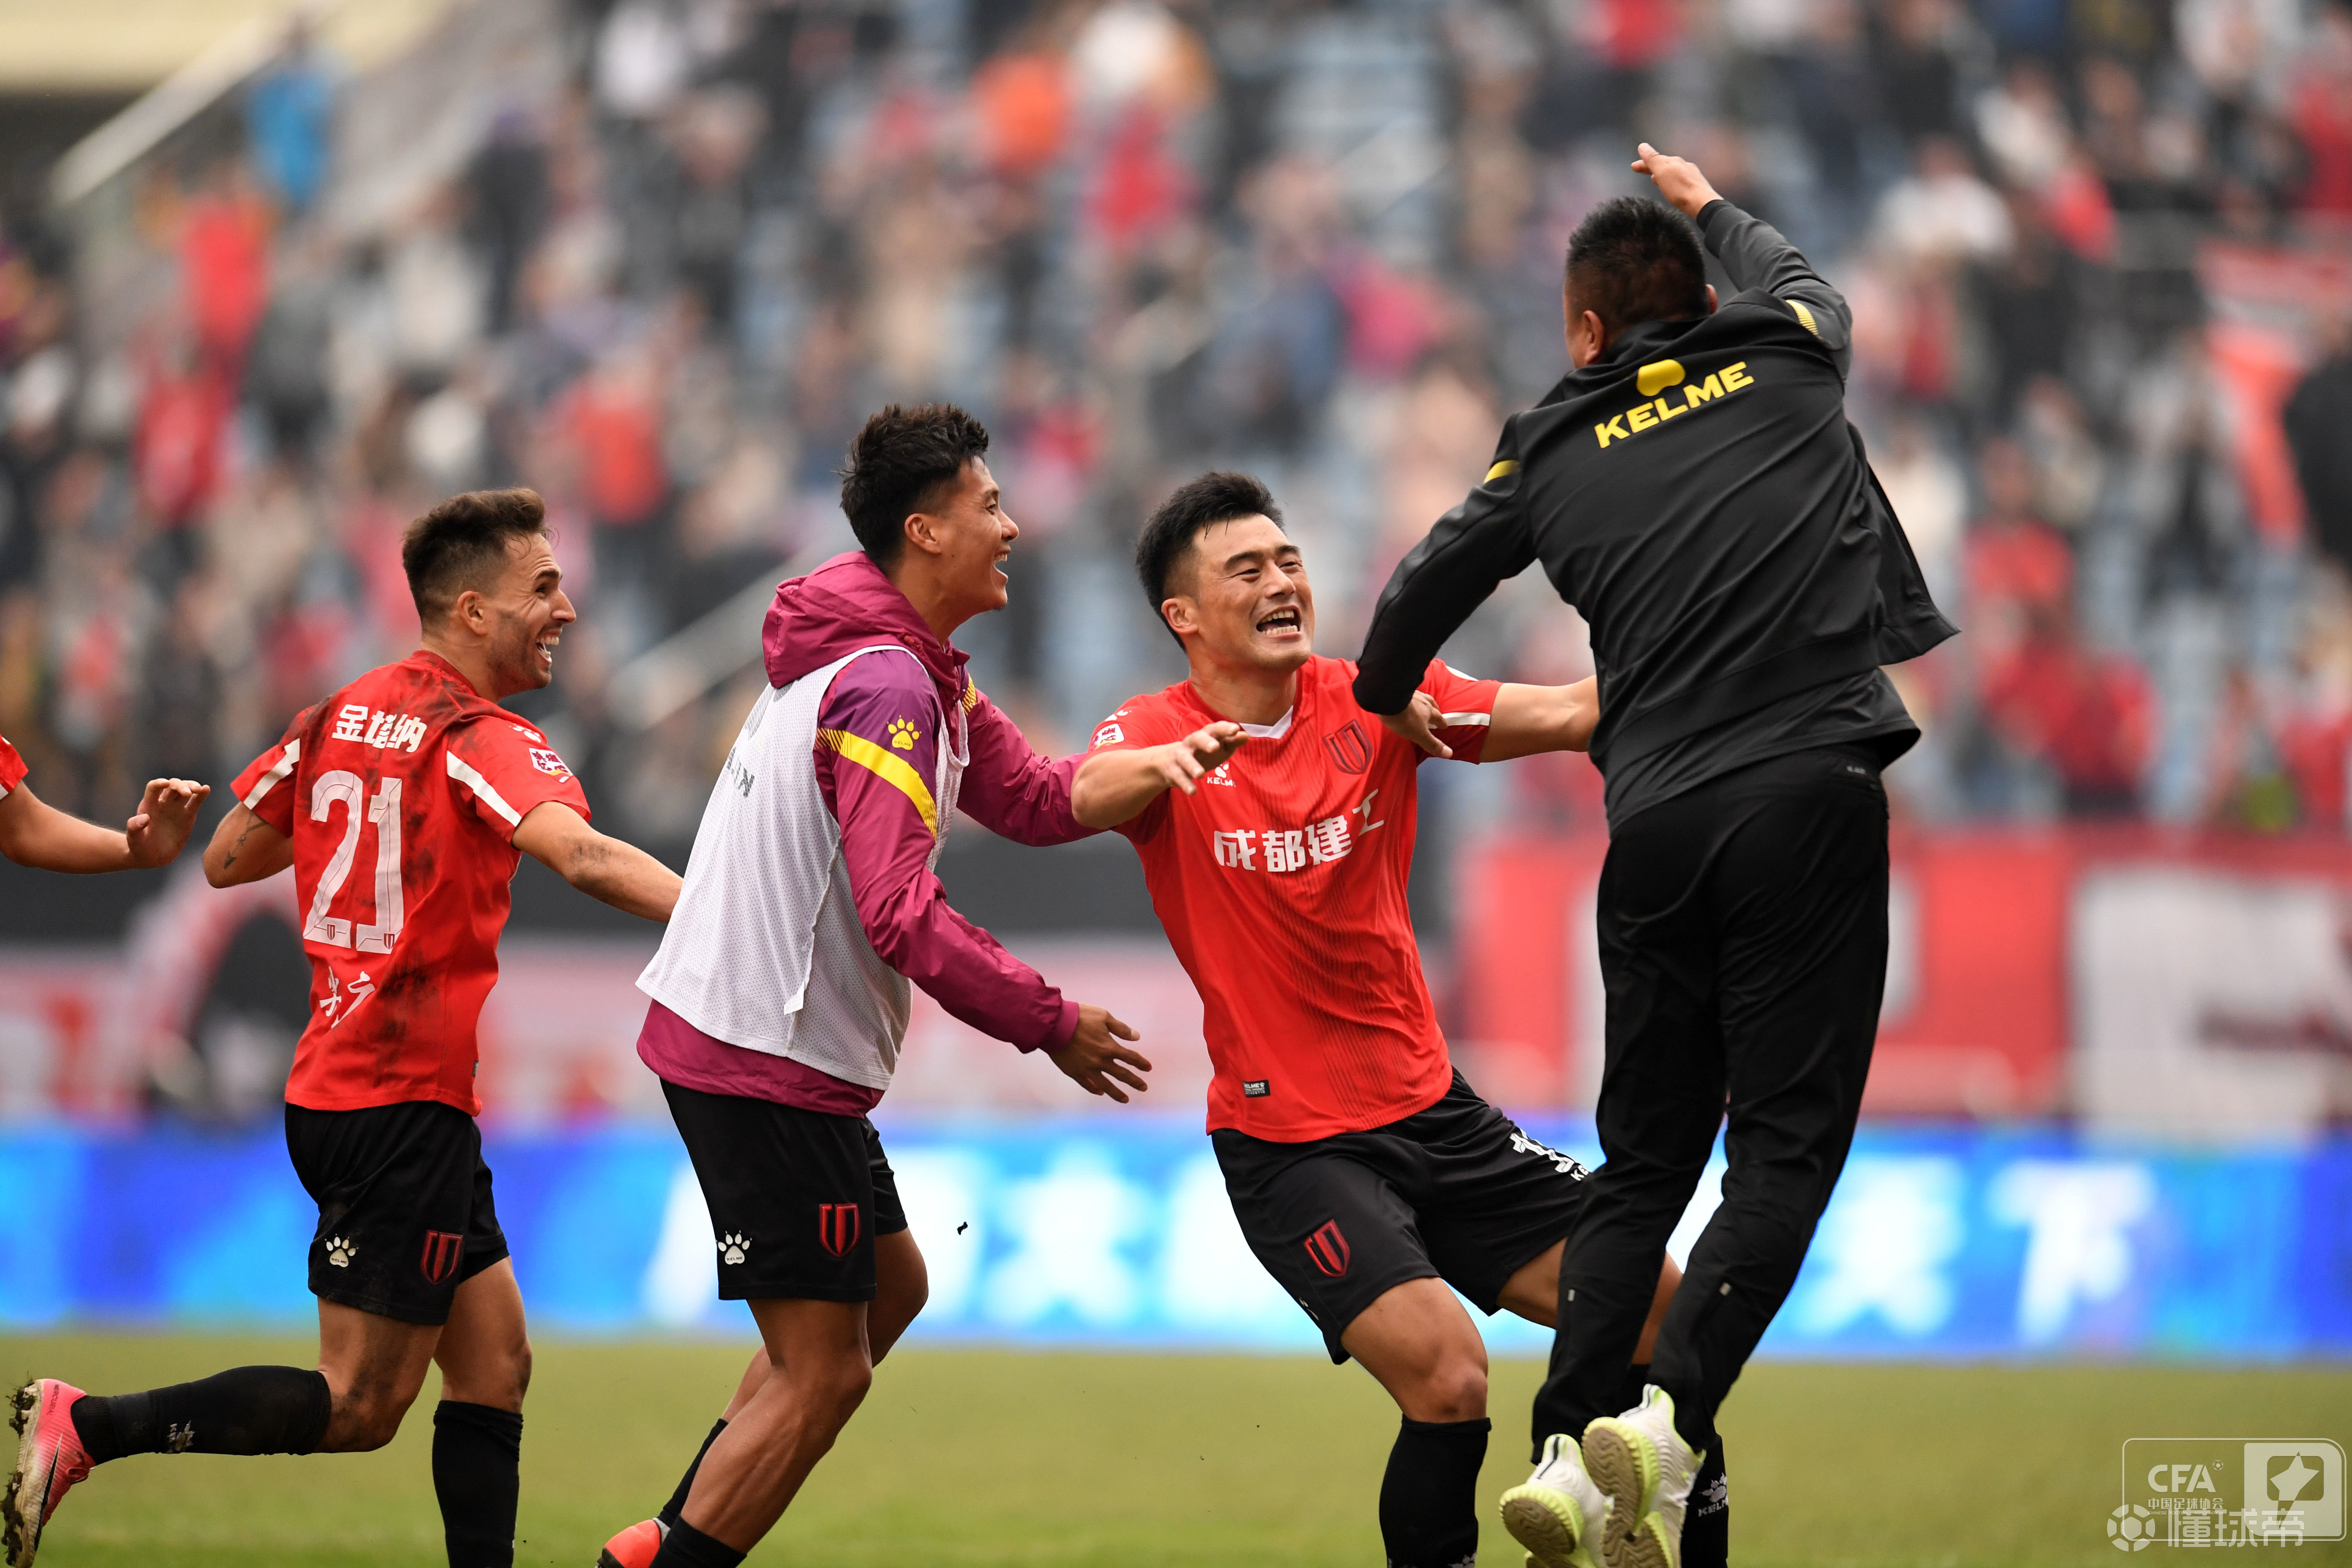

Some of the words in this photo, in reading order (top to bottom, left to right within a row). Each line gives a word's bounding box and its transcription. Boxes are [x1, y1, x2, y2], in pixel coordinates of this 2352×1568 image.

[1594, 361, 1754, 449] KELME
[303, 770, 404, 954] 21
[1214, 788, 1384, 872] 成都建工
